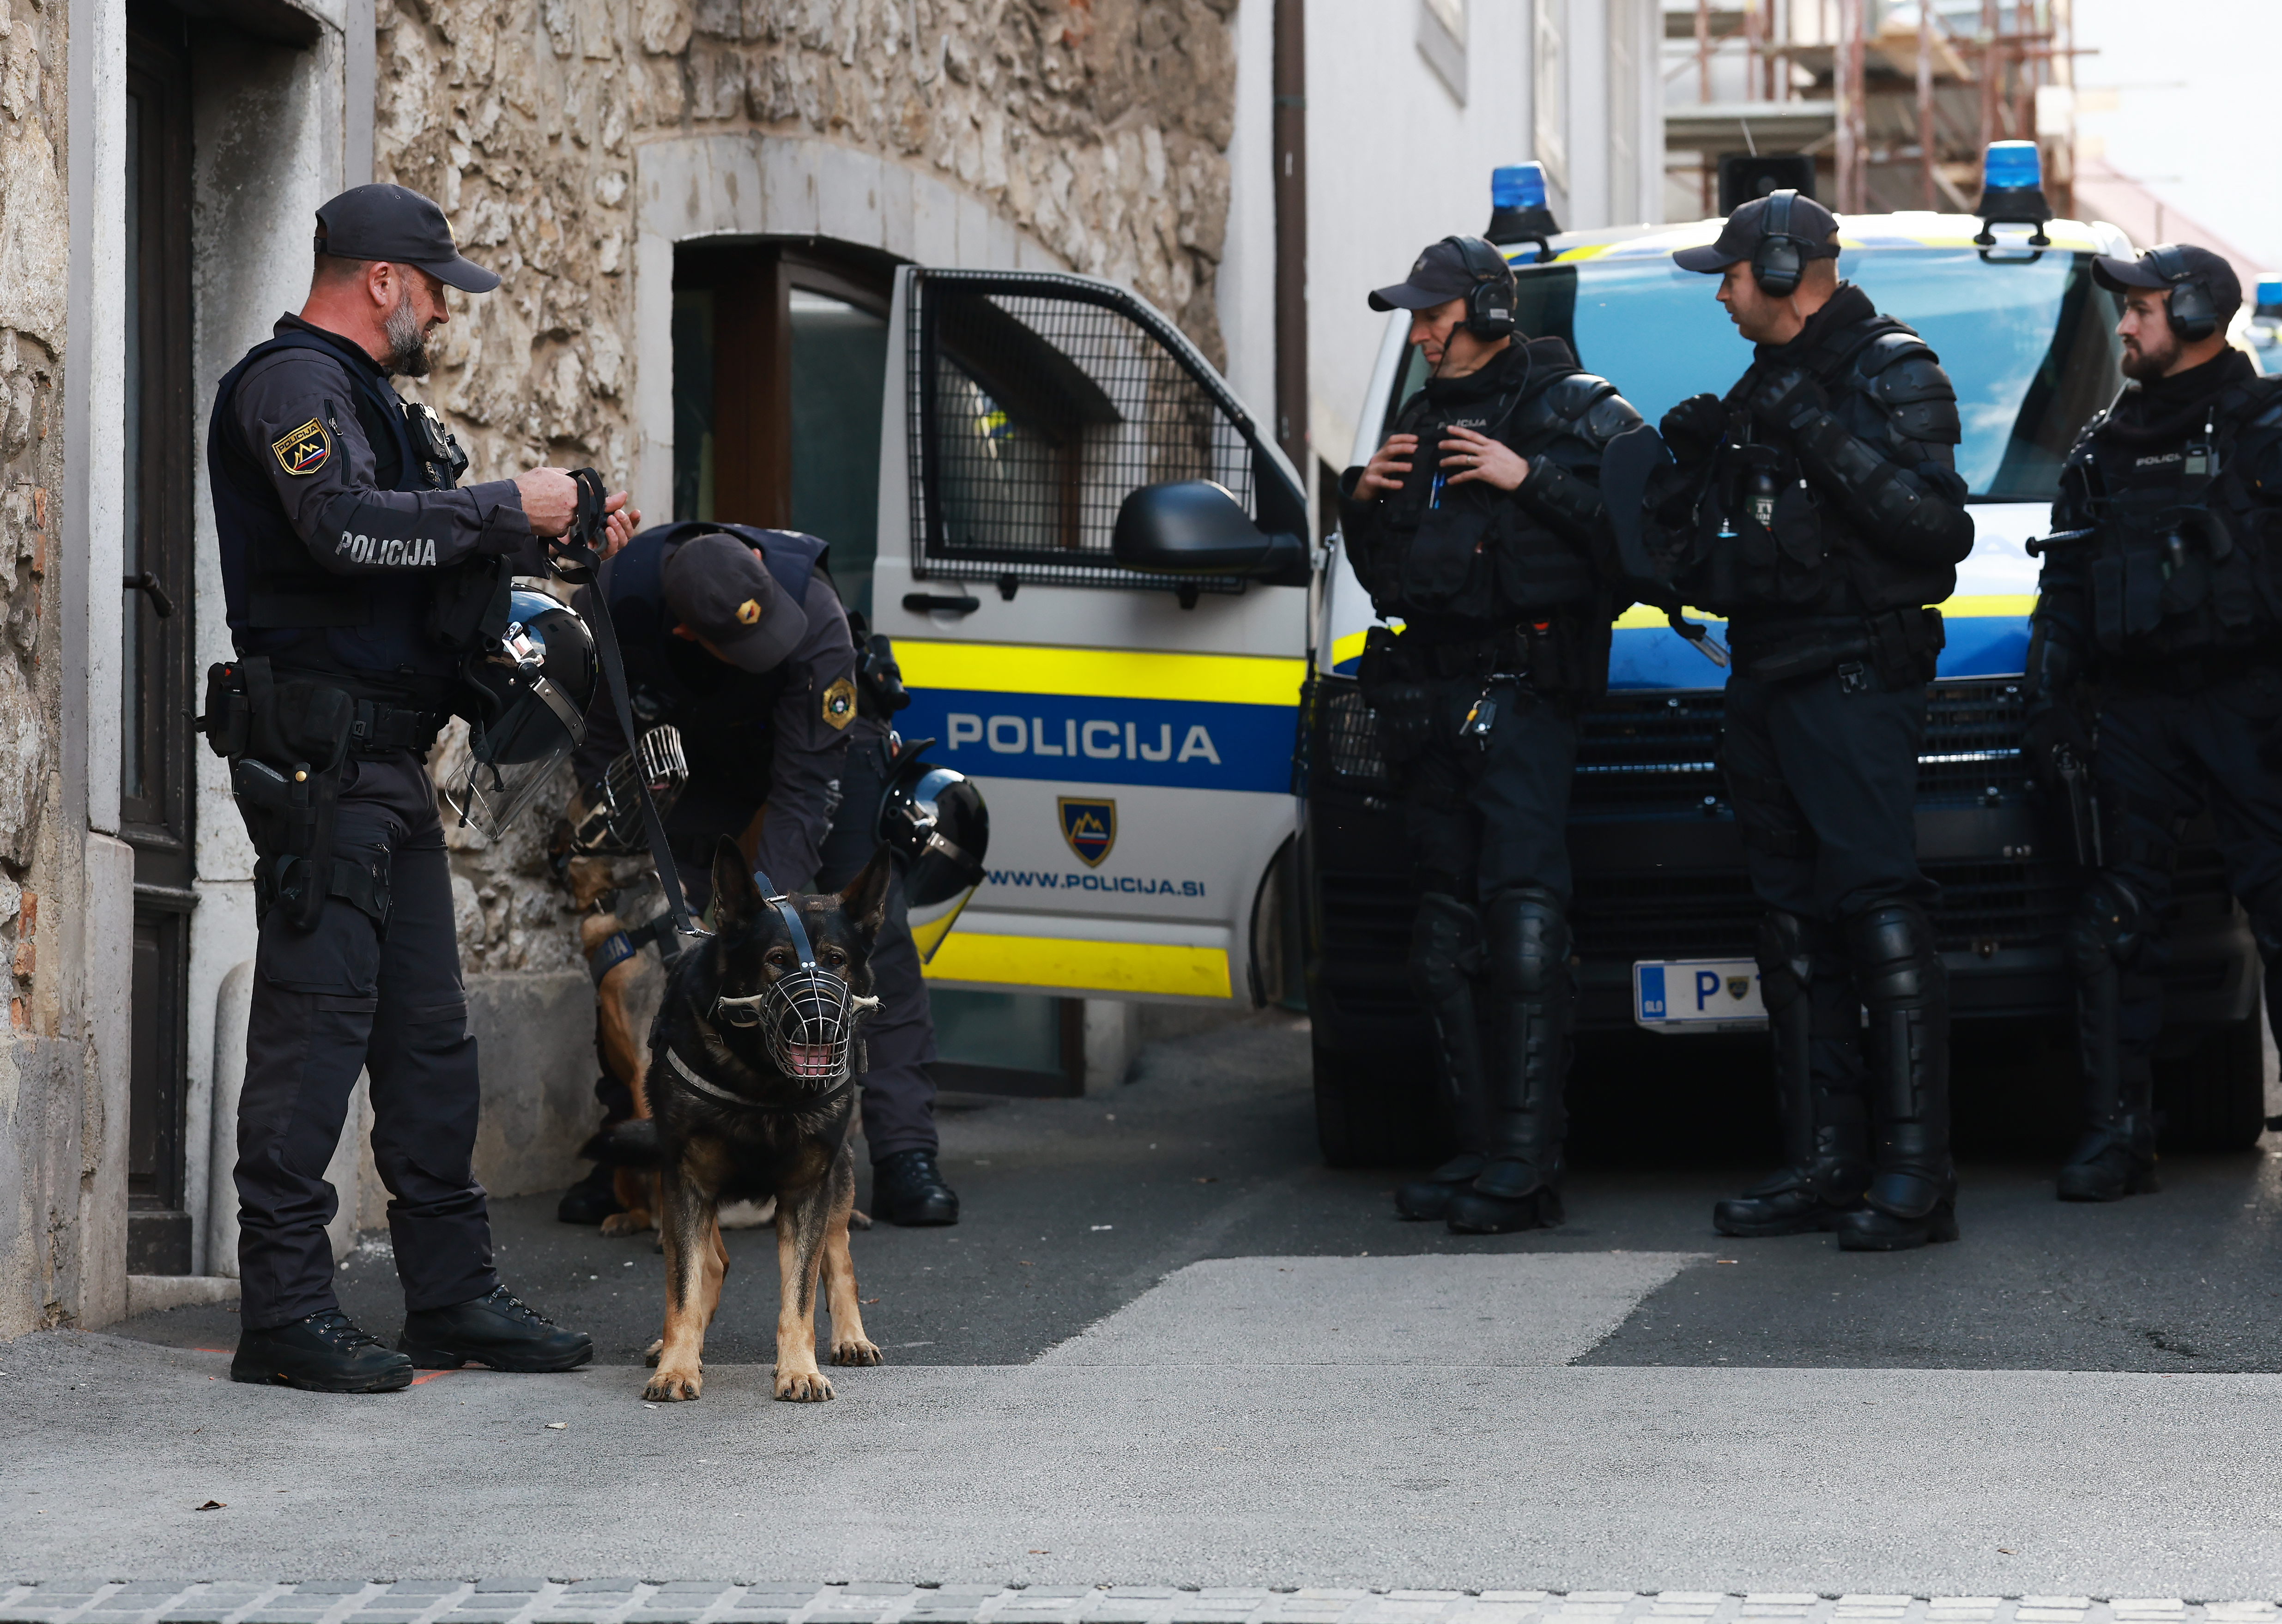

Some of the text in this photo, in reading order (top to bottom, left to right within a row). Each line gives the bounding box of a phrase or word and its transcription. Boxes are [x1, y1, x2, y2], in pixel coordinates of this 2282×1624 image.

[278, 426, 317, 452] POLICIJA
[335, 531, 436, 566] POLICIJA
[947, 712, 1222, 765] POLICIJA
[987, 869, 1205, 897] WWW.POLICIJA.SI
[1695, 971, 1719, 1010] P
